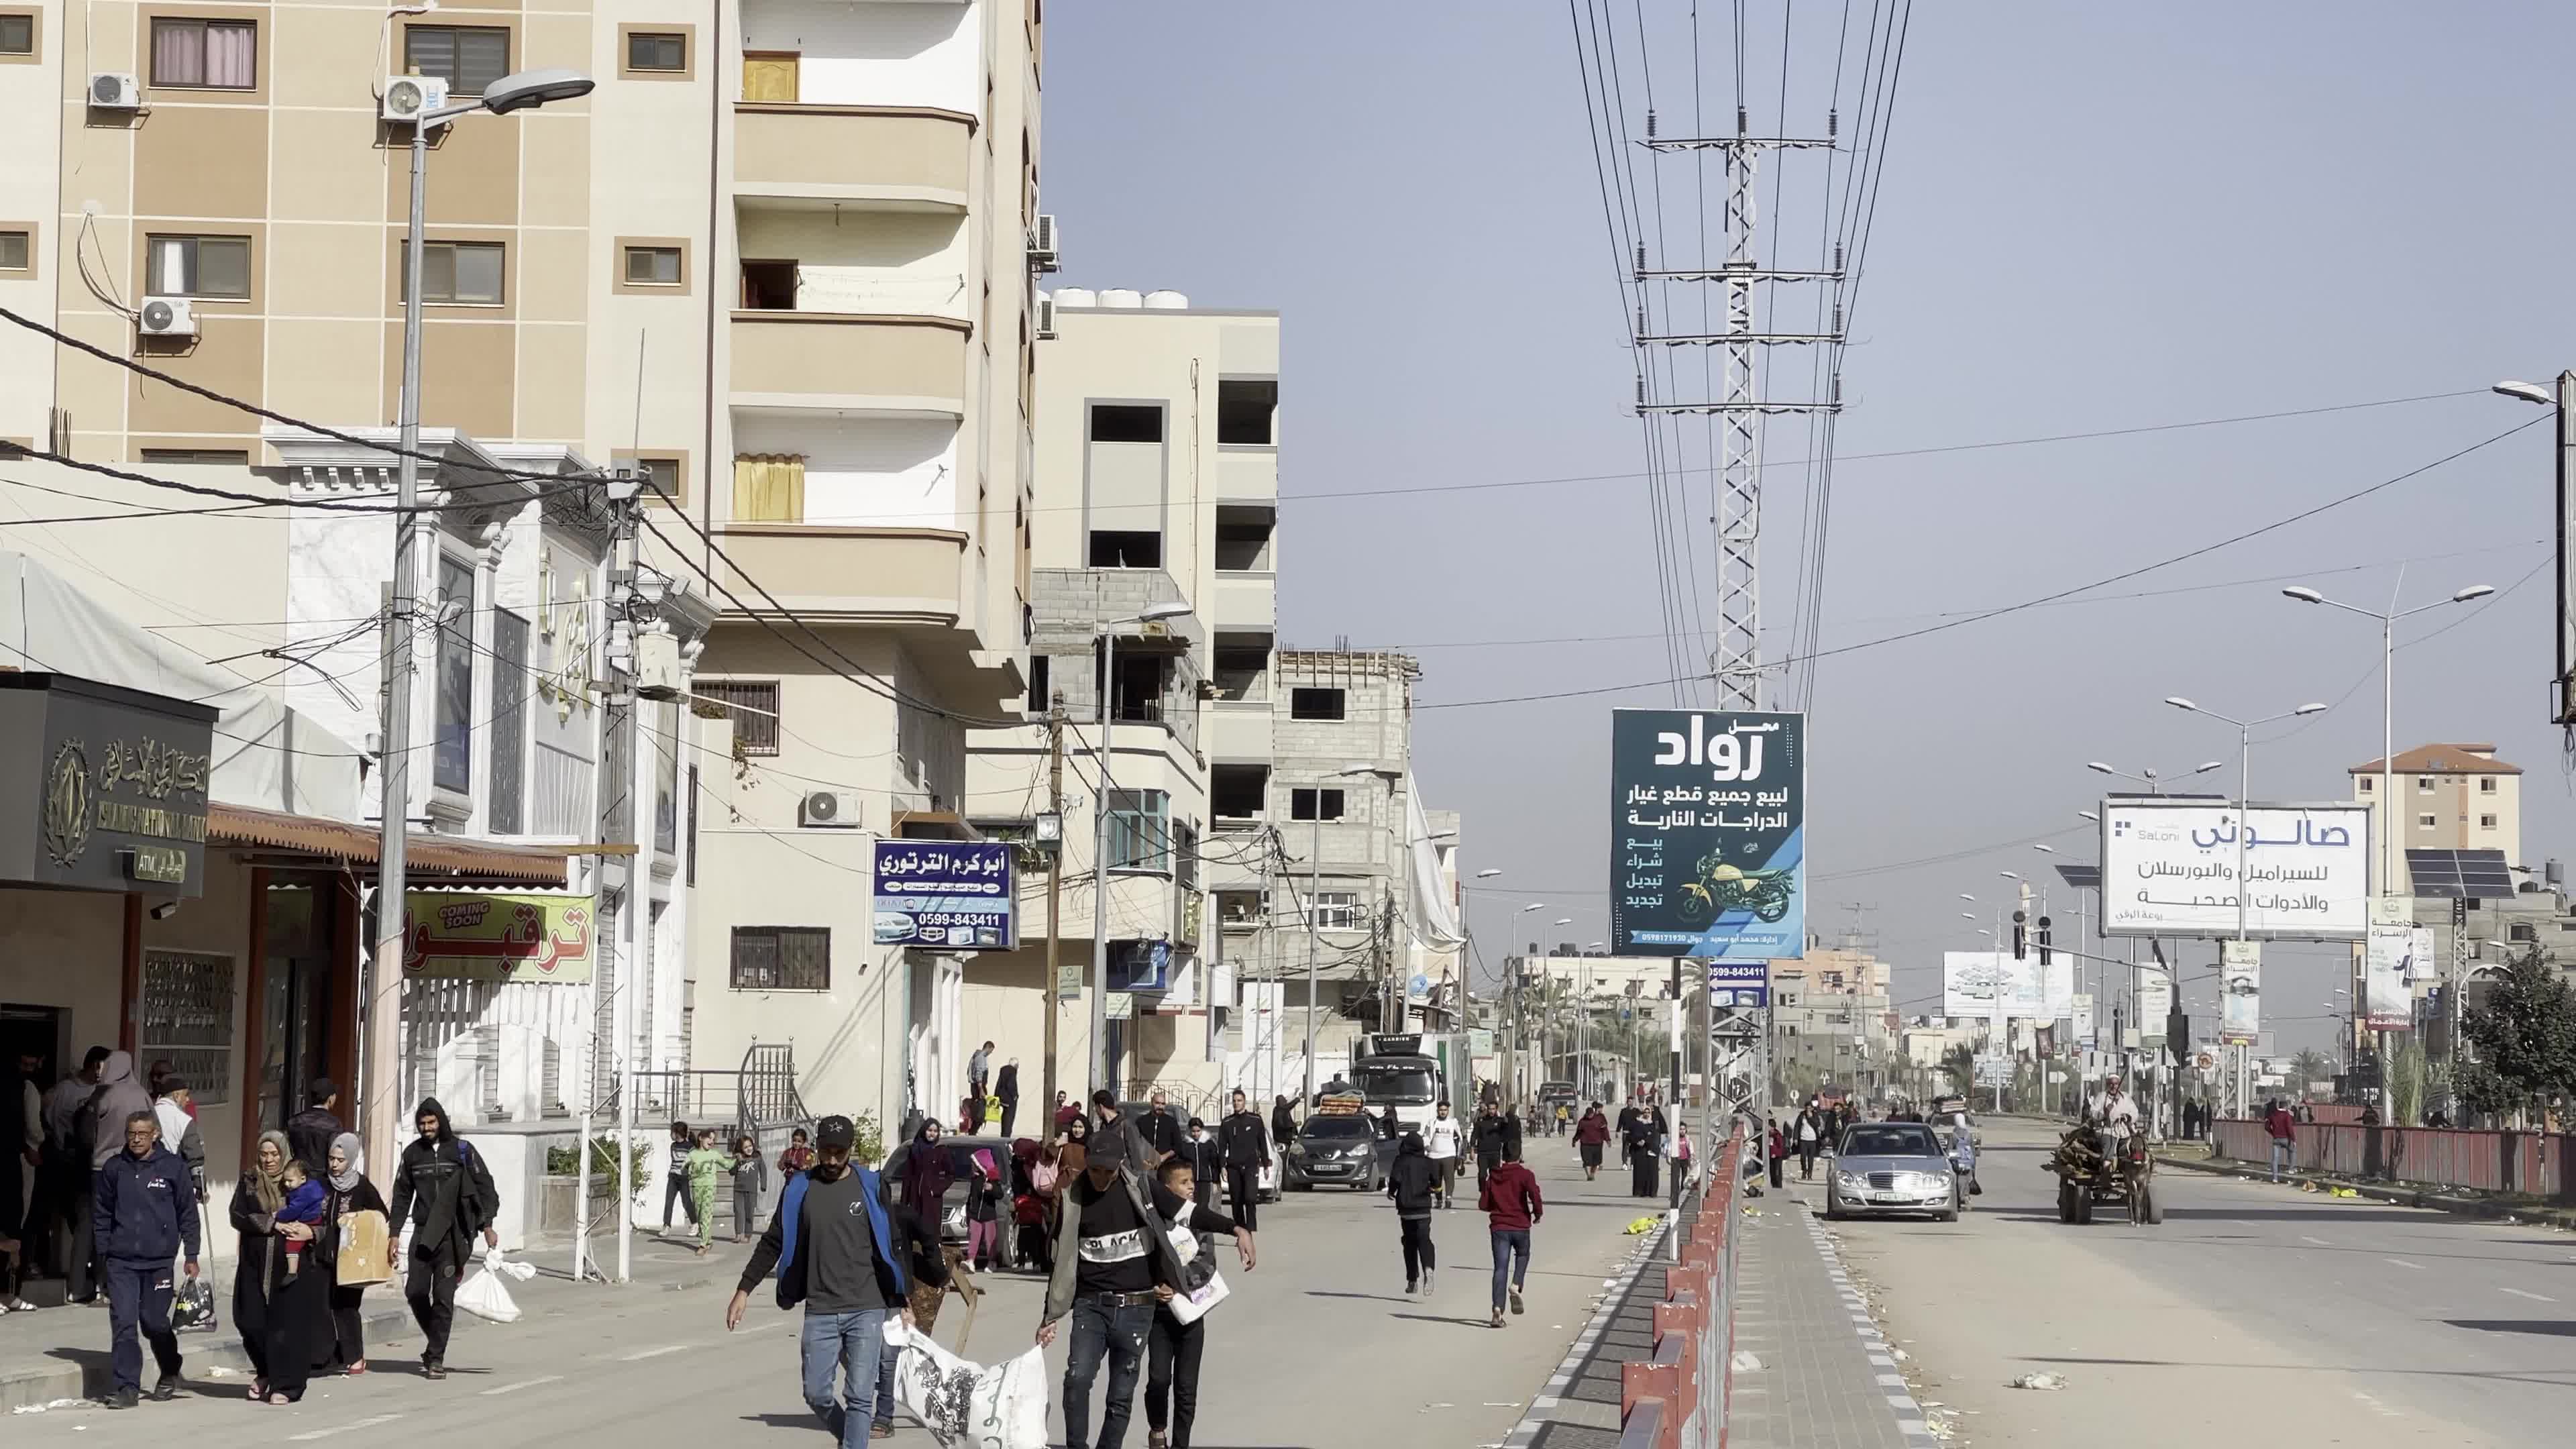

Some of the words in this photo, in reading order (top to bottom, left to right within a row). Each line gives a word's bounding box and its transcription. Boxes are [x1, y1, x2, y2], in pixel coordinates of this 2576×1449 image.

[1728, 719, 1779, 735] محل
[1655, 715, 1763, 781] رواد
[1627, 784, 1658, 804] غيار
[1663, 786, 1703, 805] قطع
[1708, 790, 1751, 806] جميع
[1756, 787, 1788, 807] لبيع
[1627, 809, 1695, 830] النارية
[1701, 812, 1788, 831] الدراجات
[1626, 838, 1663, 850] بيع
[879, 851, 949, 876] الترتوري
[952, 853, 980, 875] كرم
[982, 851, 1005, 877] أبو
[1626, 853, 1663, 870] شراء
[2138, 861, 2233, 881] والبورسلان
[1626, 873, 1663, 889] تبديل
[1626, 894, 1663, 909] تجديد
[2138, 888, 2251, 908] اصحية
[439, 902, 489, 918] COMING
[918, 913, 999, 926] 0599-843411
[444, 914, 482, 929] SOON
[2372, 917, 2412, 926] جامعة
